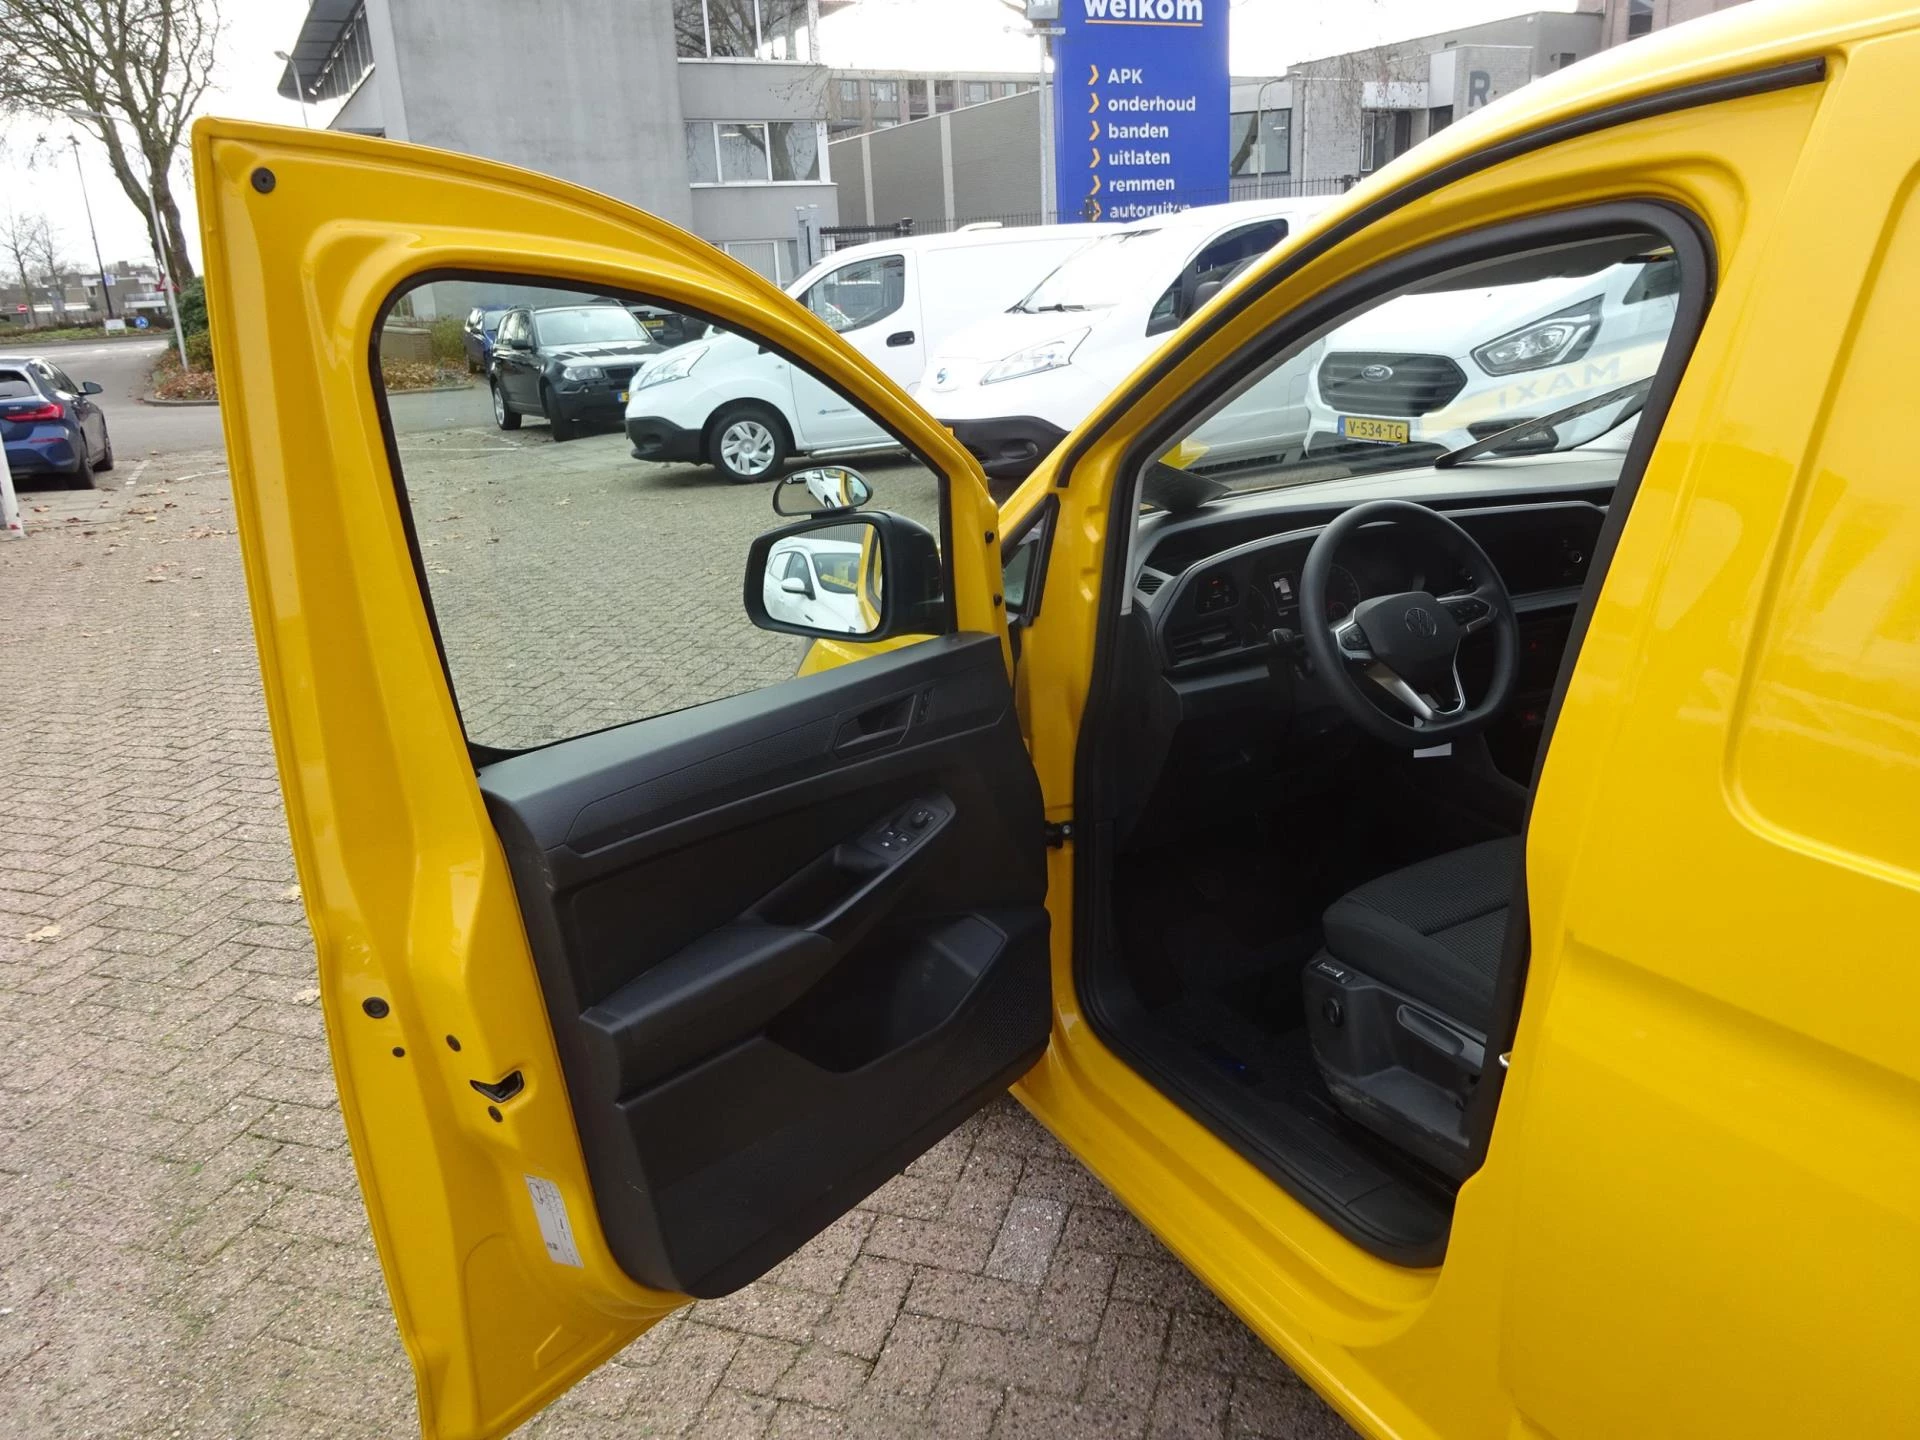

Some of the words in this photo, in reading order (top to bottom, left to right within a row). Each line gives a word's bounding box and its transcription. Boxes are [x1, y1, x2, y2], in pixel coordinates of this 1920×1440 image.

[1107, 68, 1143, 84] APK
[1468, 70, 1490, 107] R
[1107, 96, 1196, 112] onderhoud
[1108, 123, 1169, 139] banden
[1109, 149, 1170, 165] uitlaten
[1109, 178, 1175, 192] remmen
[1348, 420, 1403, 440] V-534-TG
